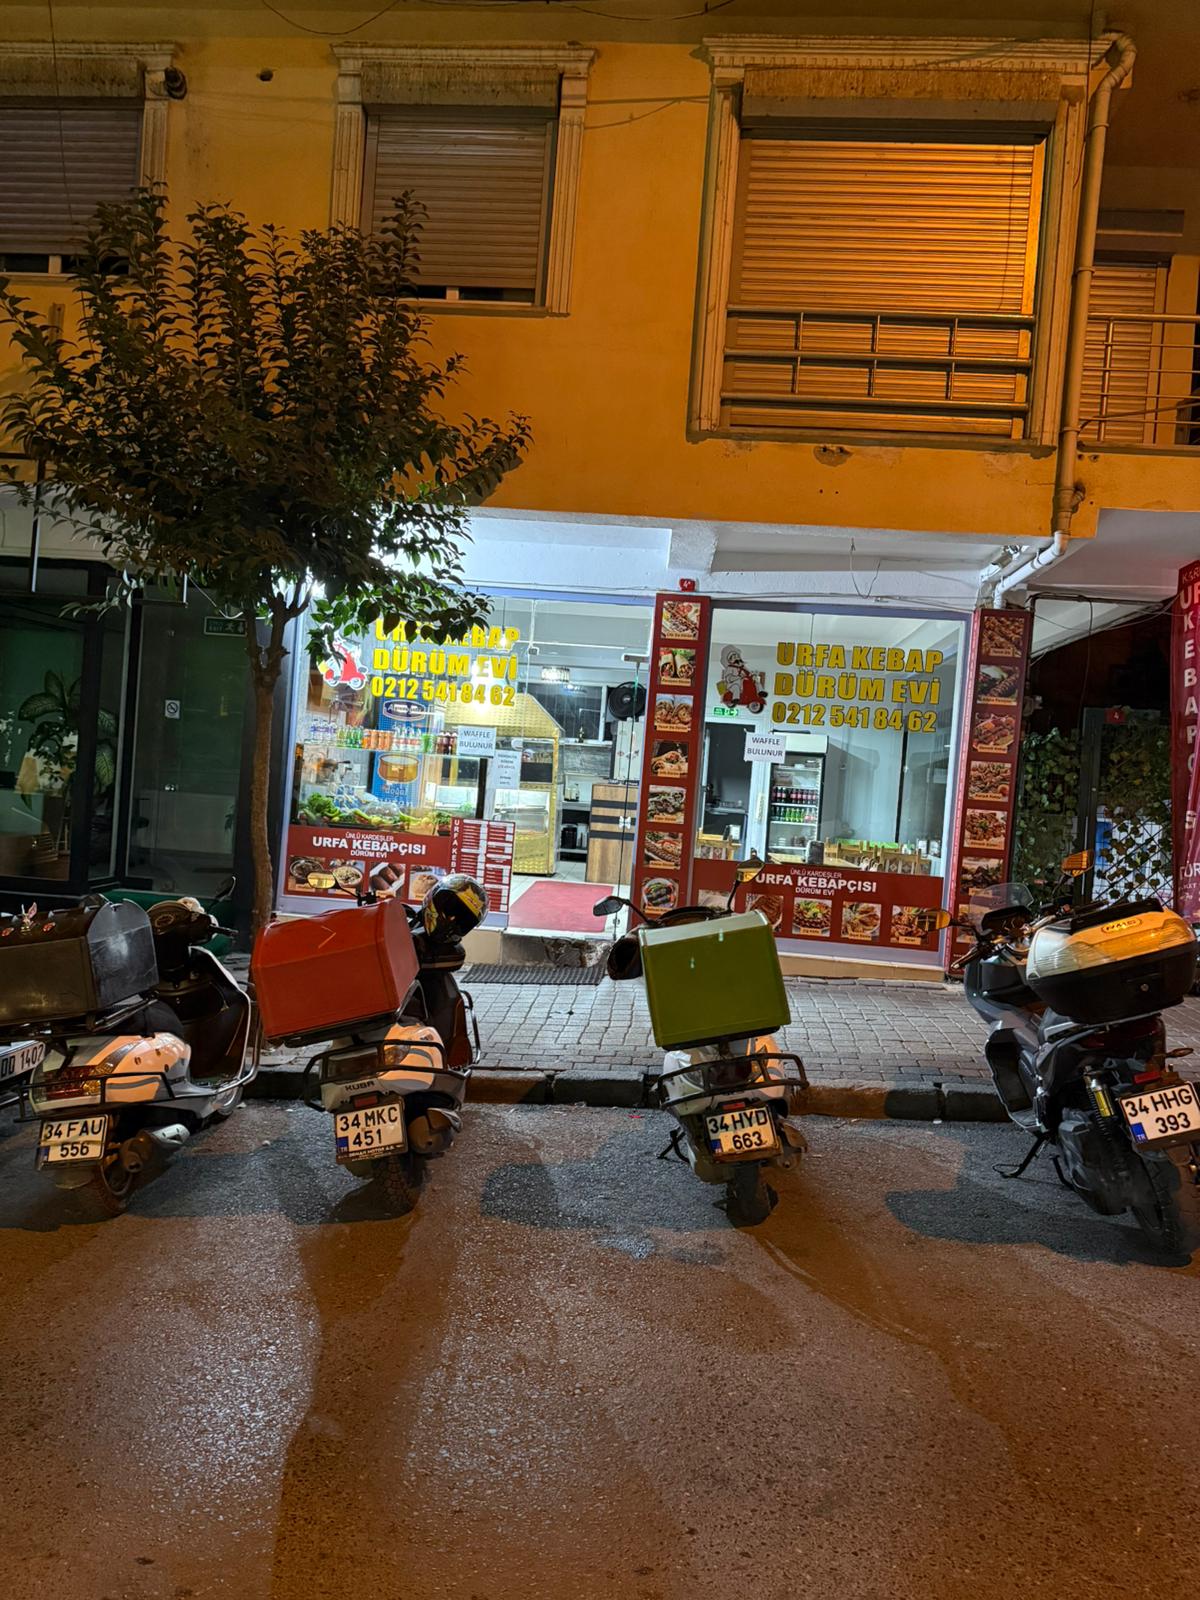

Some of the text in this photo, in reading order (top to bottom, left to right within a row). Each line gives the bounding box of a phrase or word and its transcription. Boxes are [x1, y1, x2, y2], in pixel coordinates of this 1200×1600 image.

[444, 624, 519, 649] EBAP
[373, 645, 518, 681] DÜRÜM EVİ
[777, 642, 943, 673] URFA KEBAP
[371, 676, 515, 706] 0212 541 84 62
[774, 670, 941, 704] DÜRÜM EVİ
[772, 701, 937, 732] 0212 541 84 62
[463, 730, 490, 739] WAFFLE
[752, 737, 780, 745] WAFFLE
[459, 741, 493, 750] BULUNUR
[747, 748, 783, 757] BULUNUR
[312, 836, 426, 855] URFA KEBAPÇISI
[361, 833, 394, 842] KARDEŞLER
[755, 873, 877, 893] URFA KEBAPÇISI
[790, 867, 842, 879] ÜNLÜ KARDEŞLER
[795, 886, 821, 895] DÜRÜM
[1125, 1088, 1192, 1117] 34 HHG
[44, 1119, 103, 1139] 34 FAU
[340, 1107, 398, 1131] 34 MKC
[709, 1110, 768, 1134] 34 HYD
[1155, 1112, 1190, 1134] 393
[353, 1128, 382, 1147] 451
[733, 1131, 762, 1150] 663
[60, 1141, 89, 1157] 556
